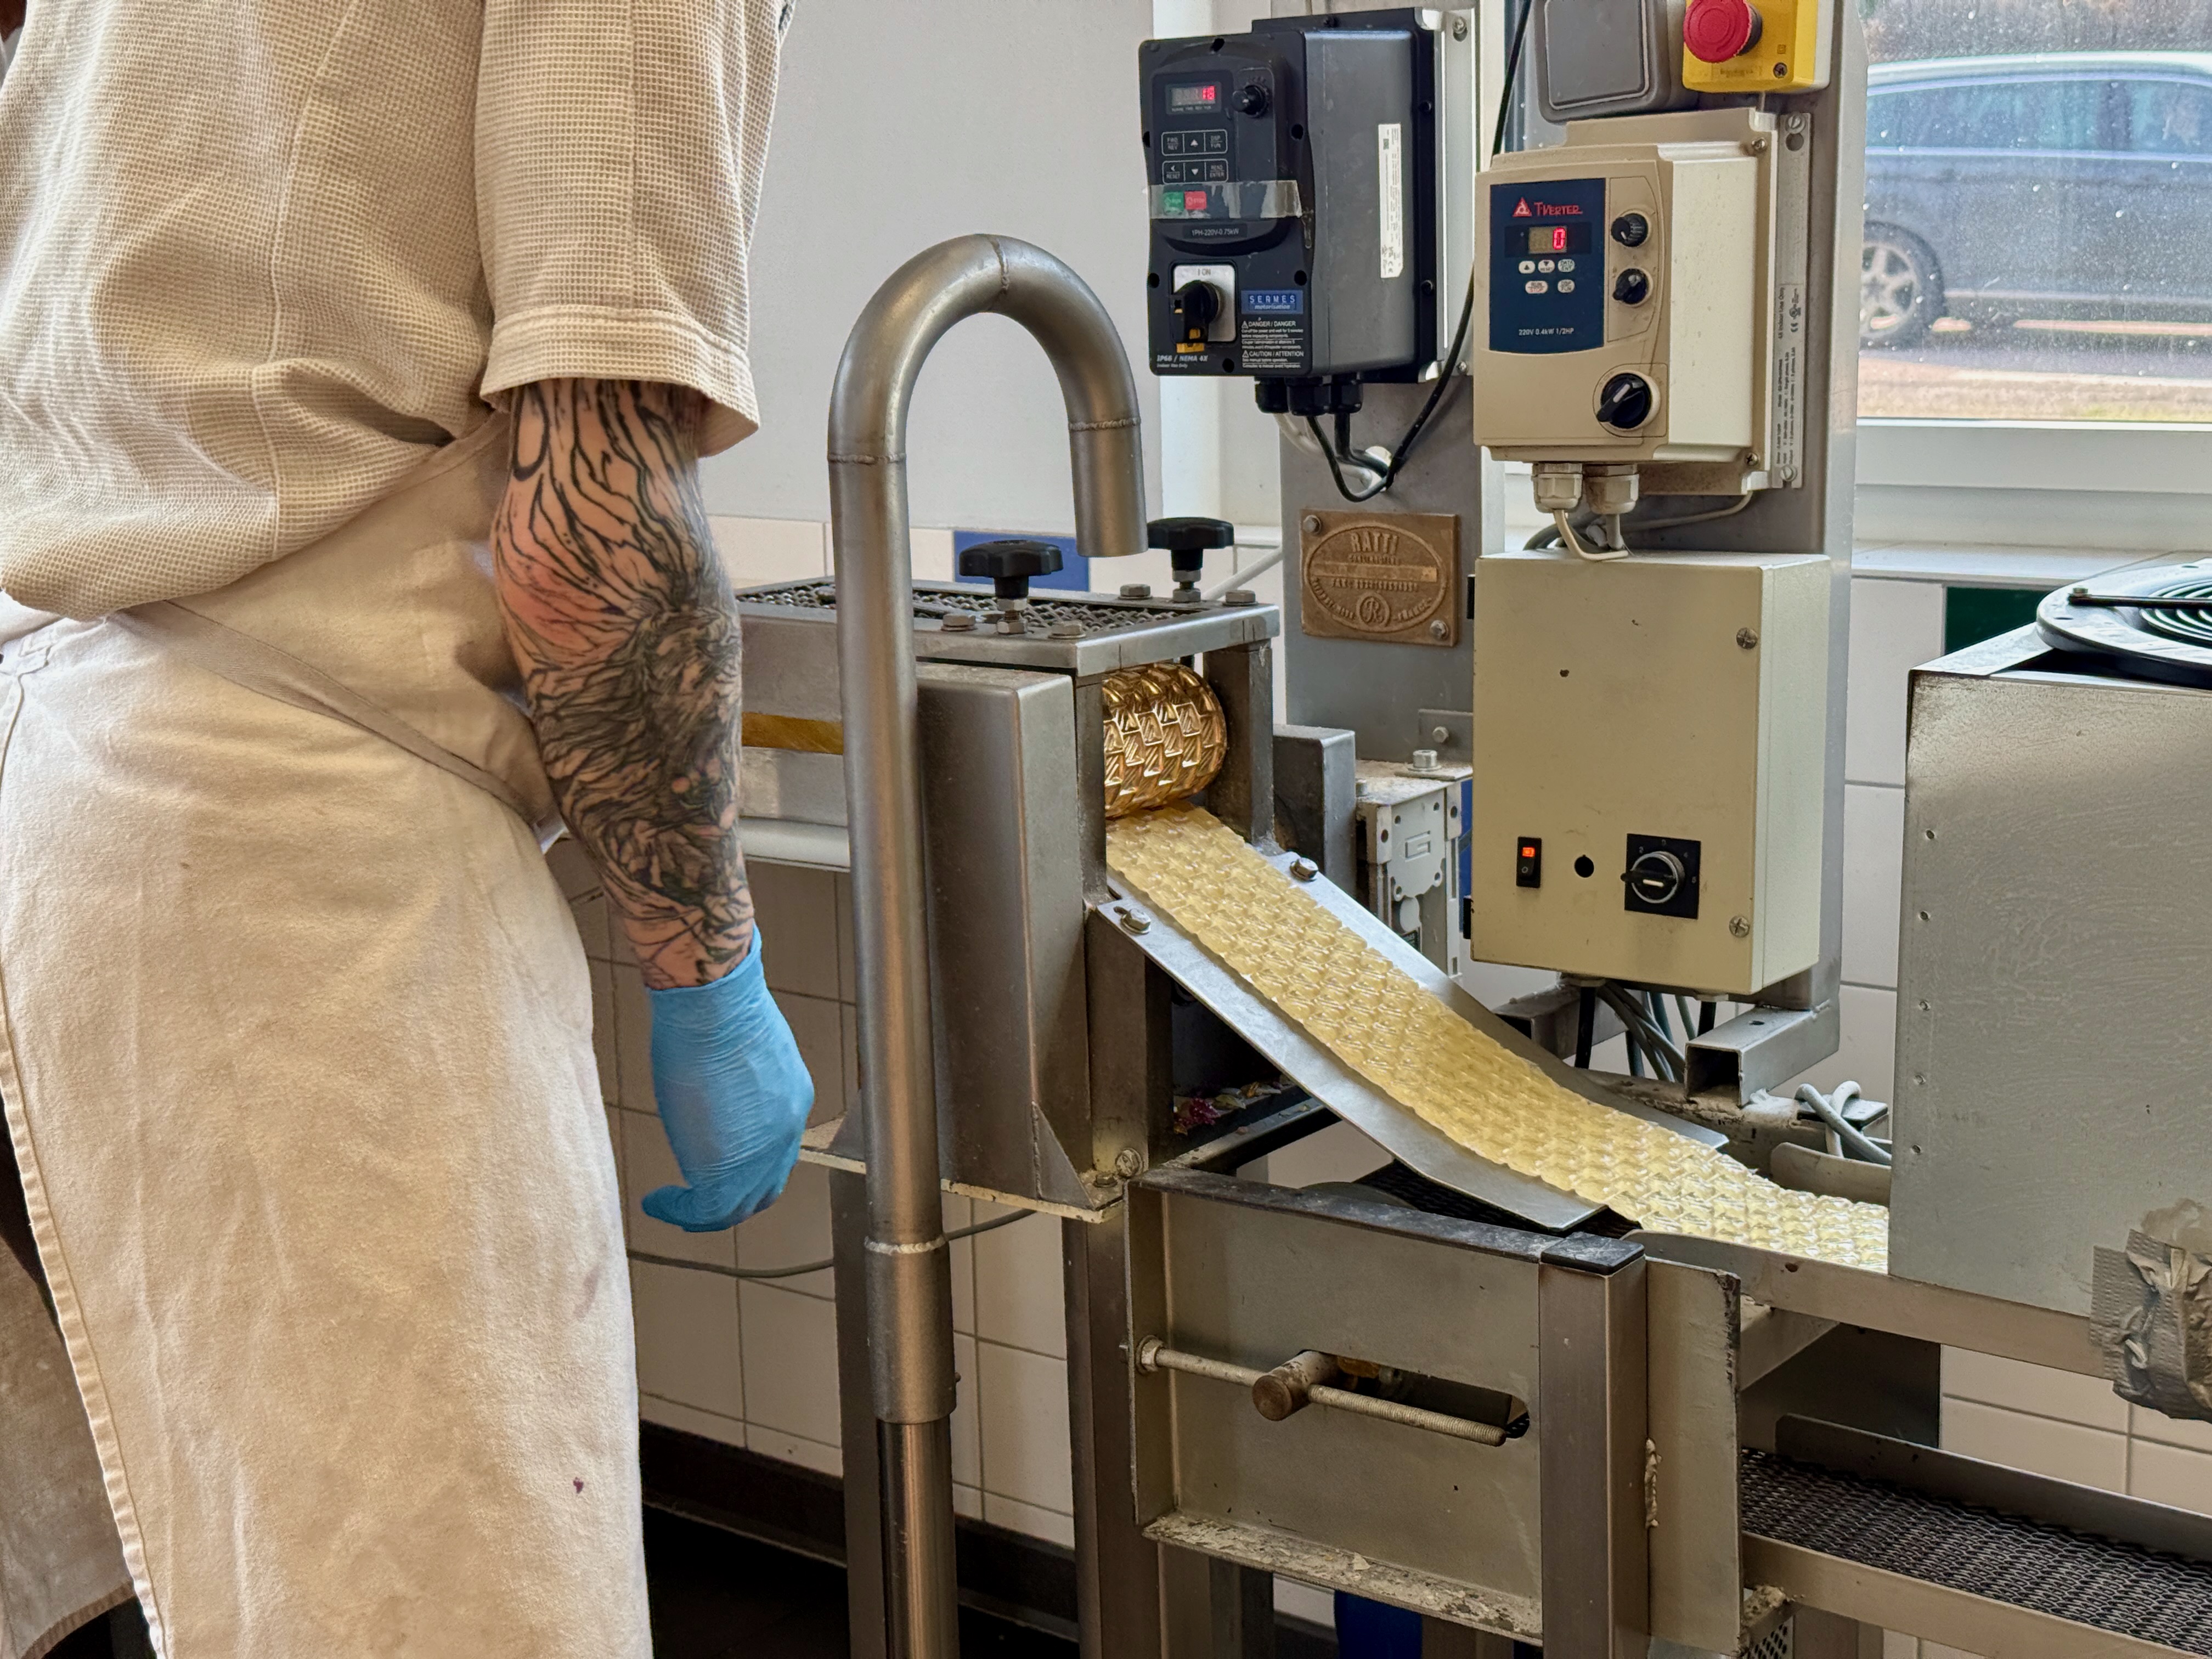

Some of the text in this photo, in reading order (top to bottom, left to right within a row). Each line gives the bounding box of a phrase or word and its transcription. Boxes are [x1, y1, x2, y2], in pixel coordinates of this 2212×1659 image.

[1553, 228, 1566, 250] 0
[1249, 295, 1296, 303] SERMES
[1350, 531, 1399, 556] RATTI
